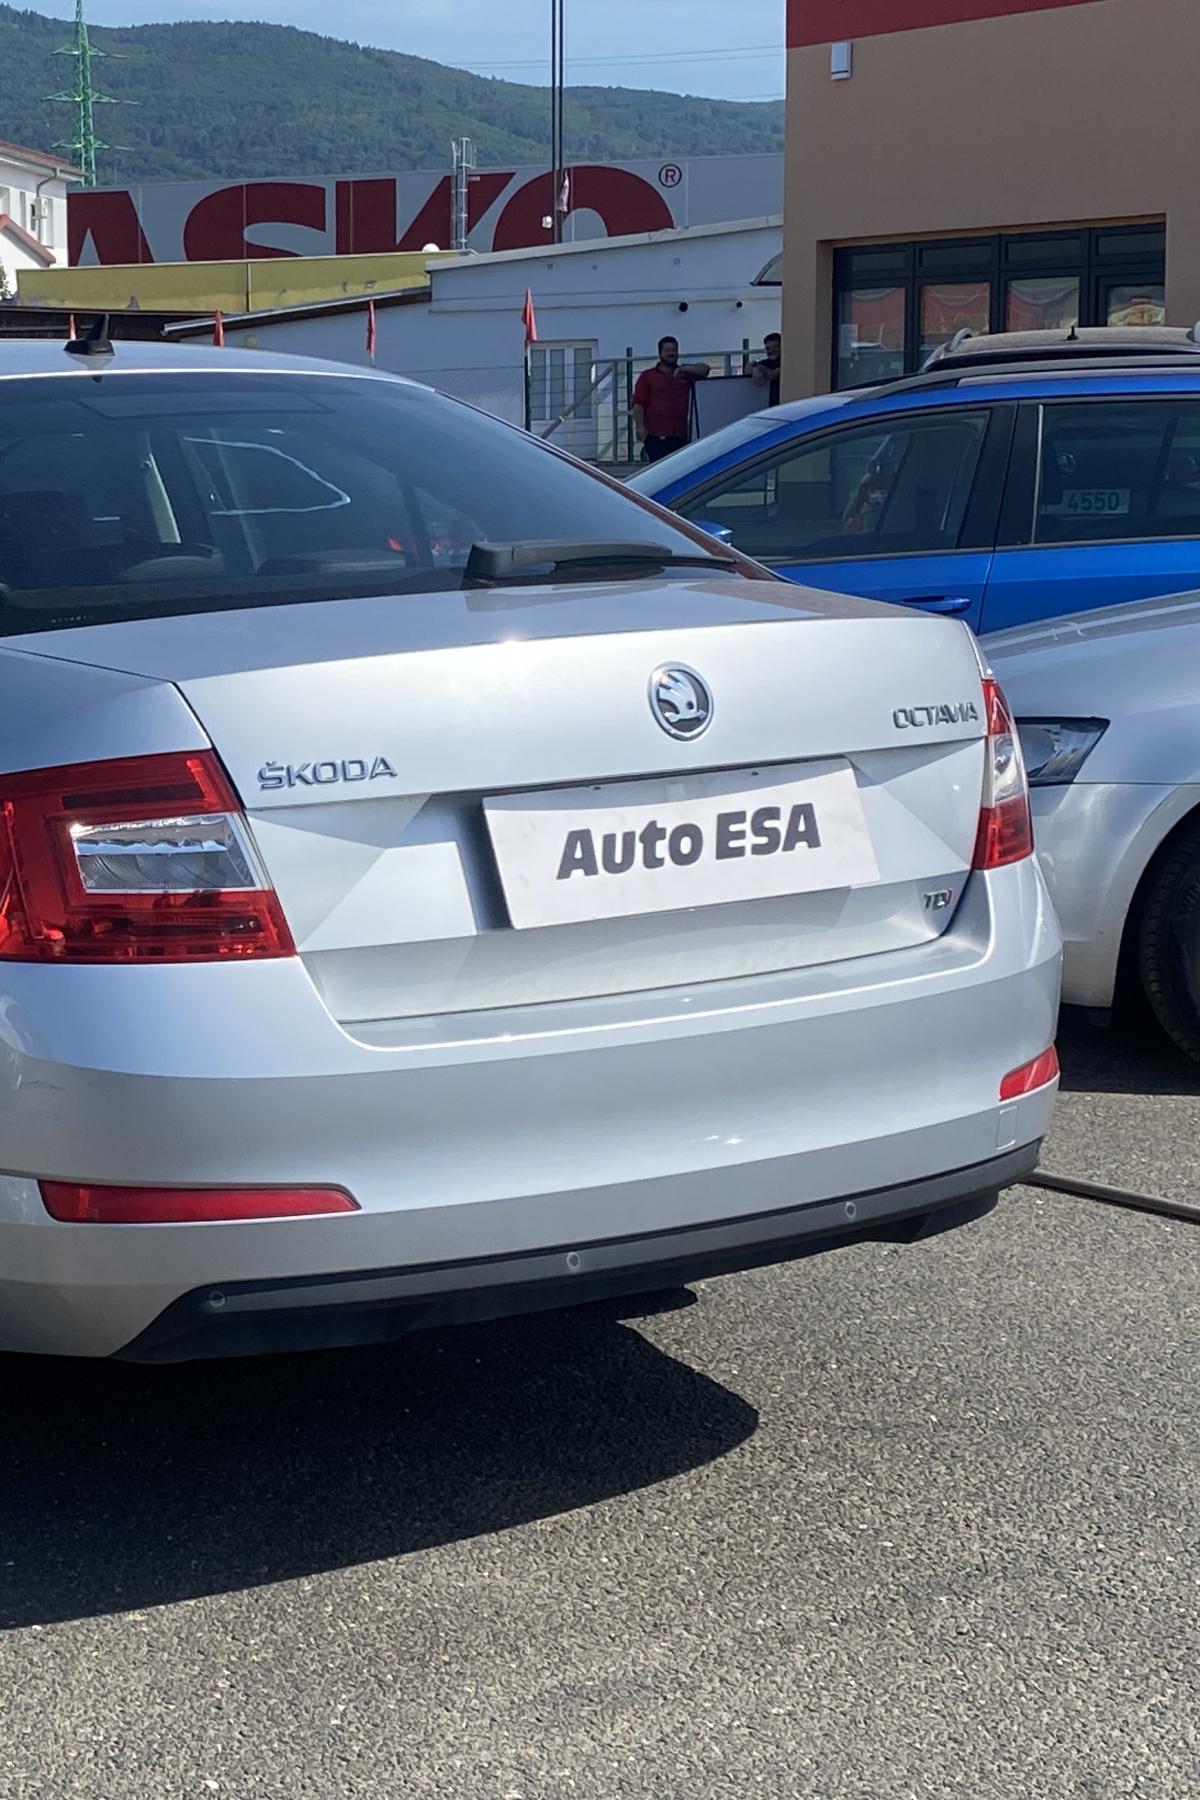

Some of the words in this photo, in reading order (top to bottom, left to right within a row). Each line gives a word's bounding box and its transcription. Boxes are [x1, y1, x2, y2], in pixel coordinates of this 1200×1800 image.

[1067, 491, 1121, 512] 4550
[892, 701, 979, 729] OCTAVIA
[257, 756, 398, 791] ŠKODA
[557, 820, 704, 880] Auto
[715, 802, 822, 860] ESA
